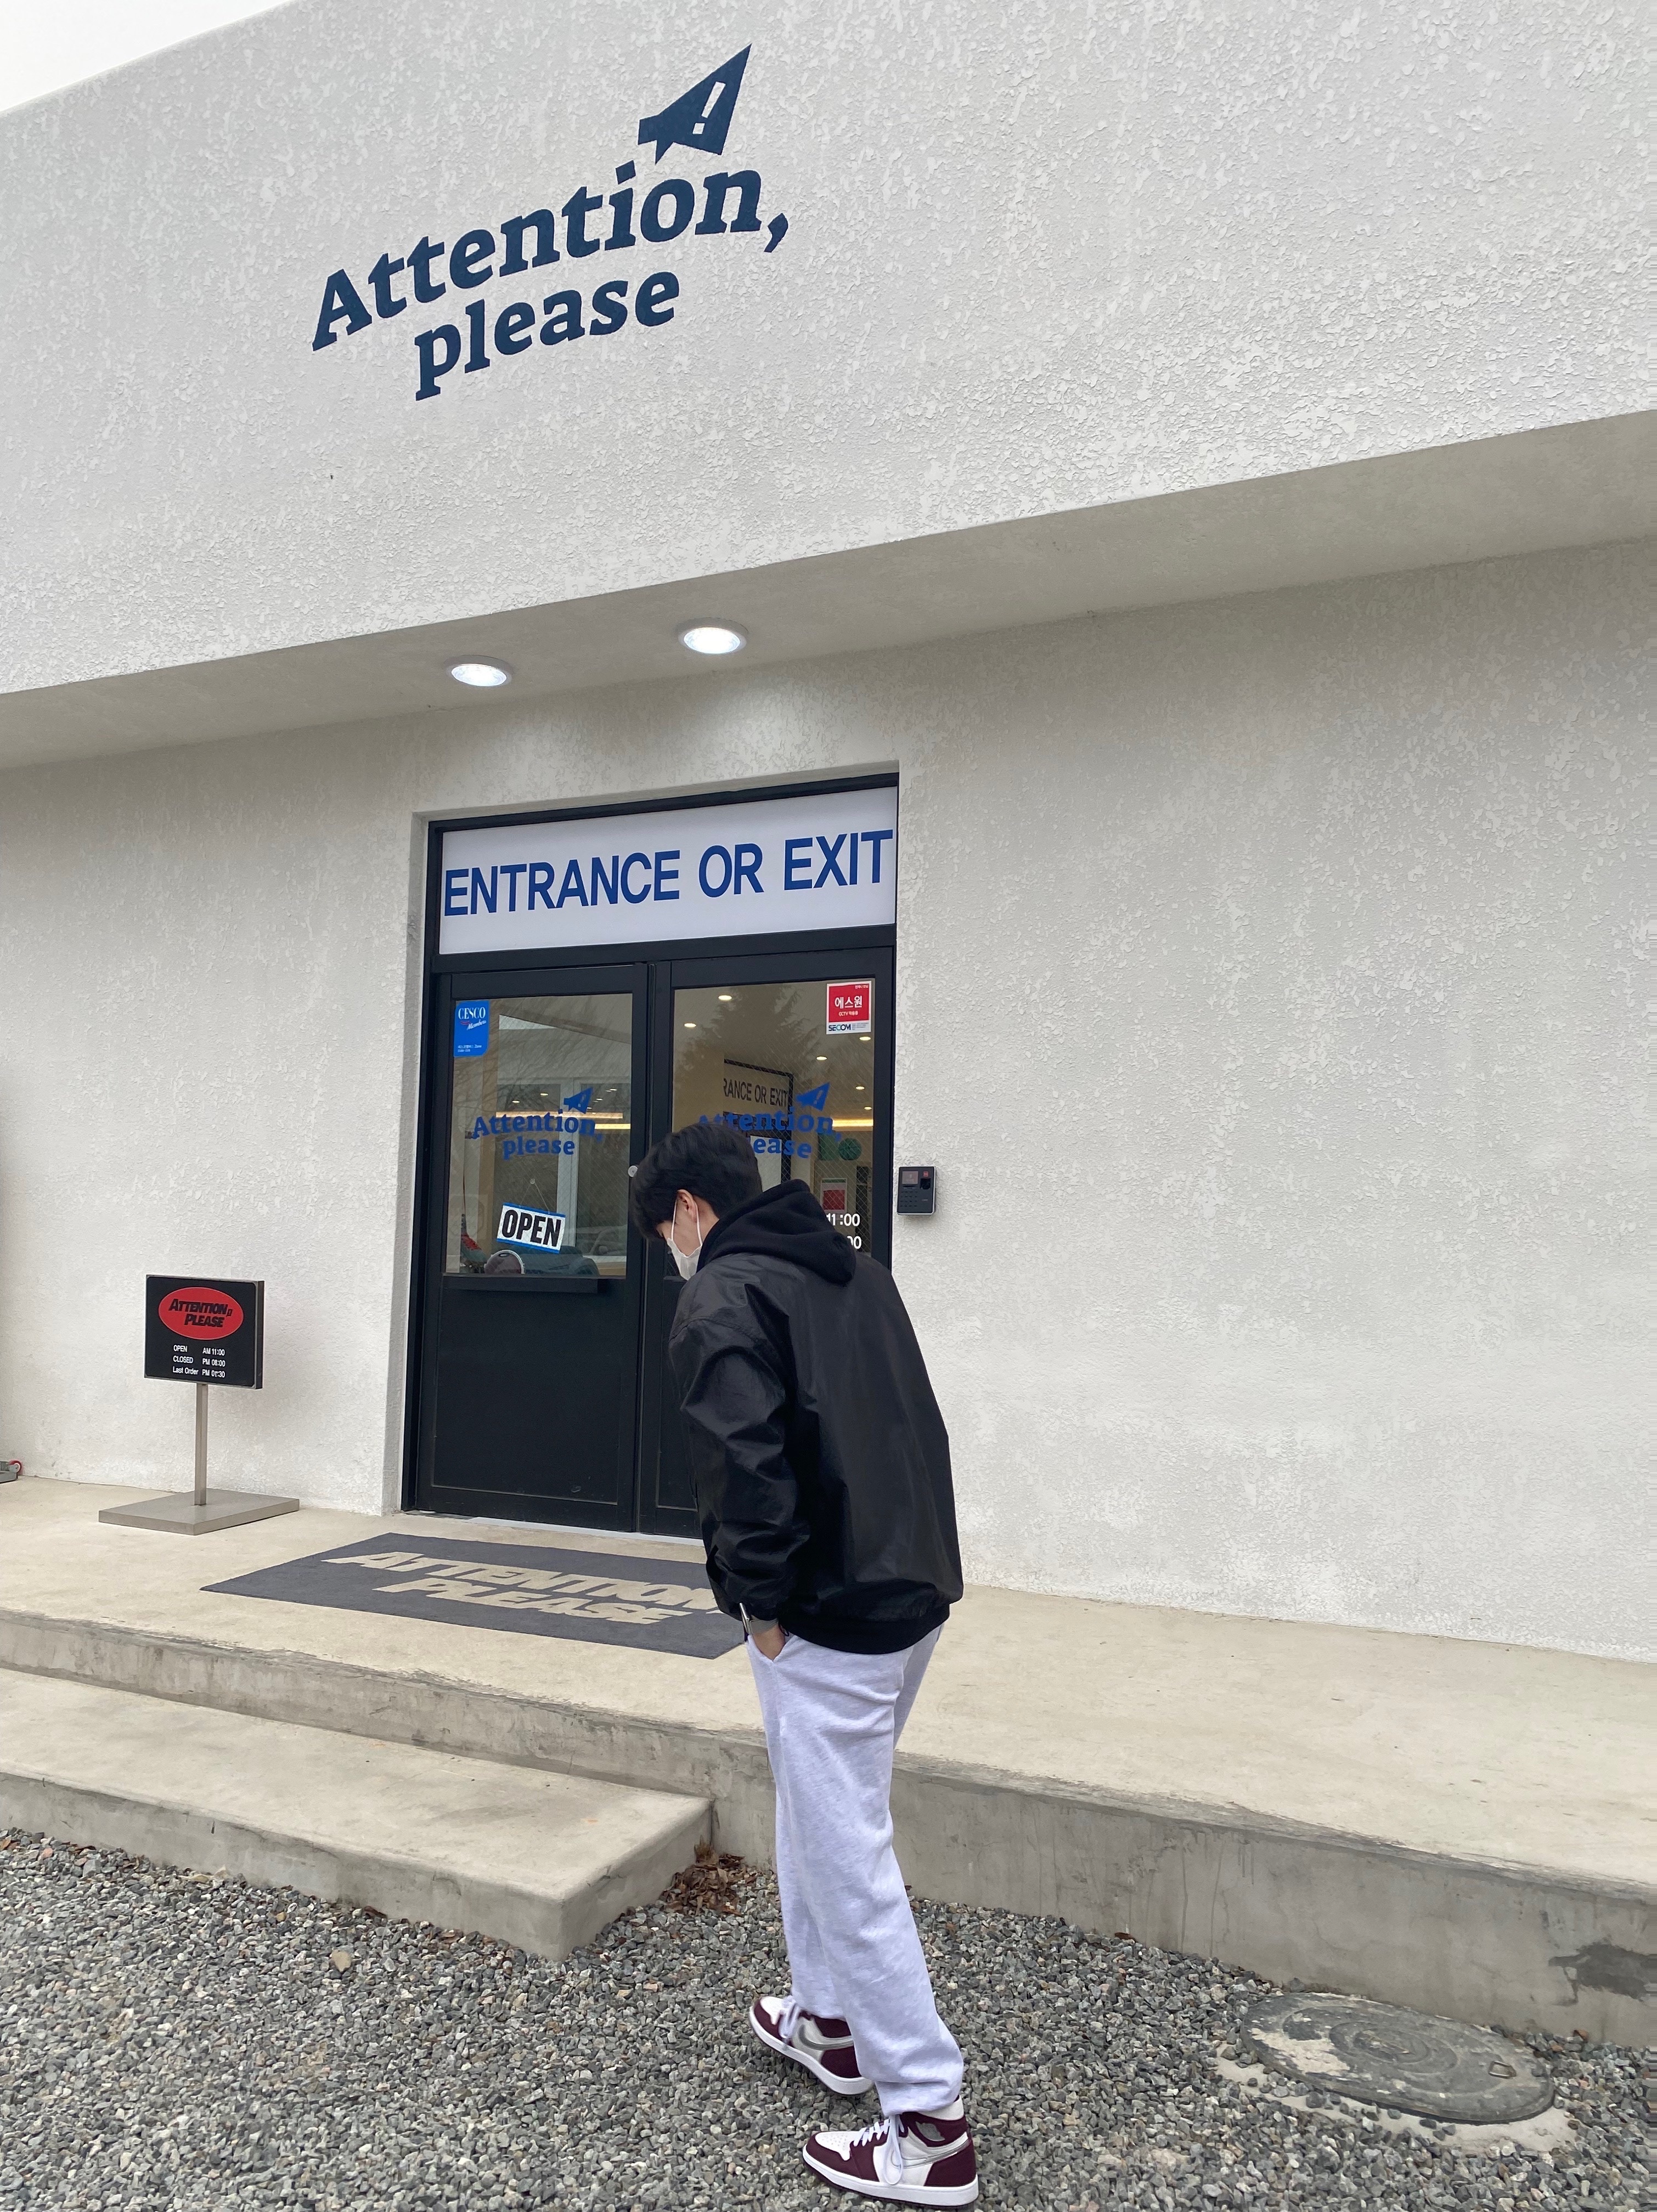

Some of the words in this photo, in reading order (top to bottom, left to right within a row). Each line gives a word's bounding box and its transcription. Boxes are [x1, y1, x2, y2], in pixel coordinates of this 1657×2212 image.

[312, 160, 788, 352] Attention,
[414, 272, 680, 401] please
[444, 850, 680, 917] ENTRANCE
[698, 843, 764, 898] OR
[784, 830, 893, 891] EXIT
[458, 1007, 486, 1019] CESCO
[835, 995, 862, 1009] 에스원
[754, 1084, 767, 1104] OR
[770, 1088, 788, 1107] EXIT
[473, 1108, 603, 1143] Attention,
[503, 1136, 576, 1160] please
[501, 1209, 561, 1247] OPEN
[184, 1313, 225, 1328] PLEASE
[173, 1355, 194, 1363] CLOSED
[212, 1348, 226, 1356] 11:00
[172, 1365, 184, 1374] Last
[372, 1578, 693, 1624] PLEASE
